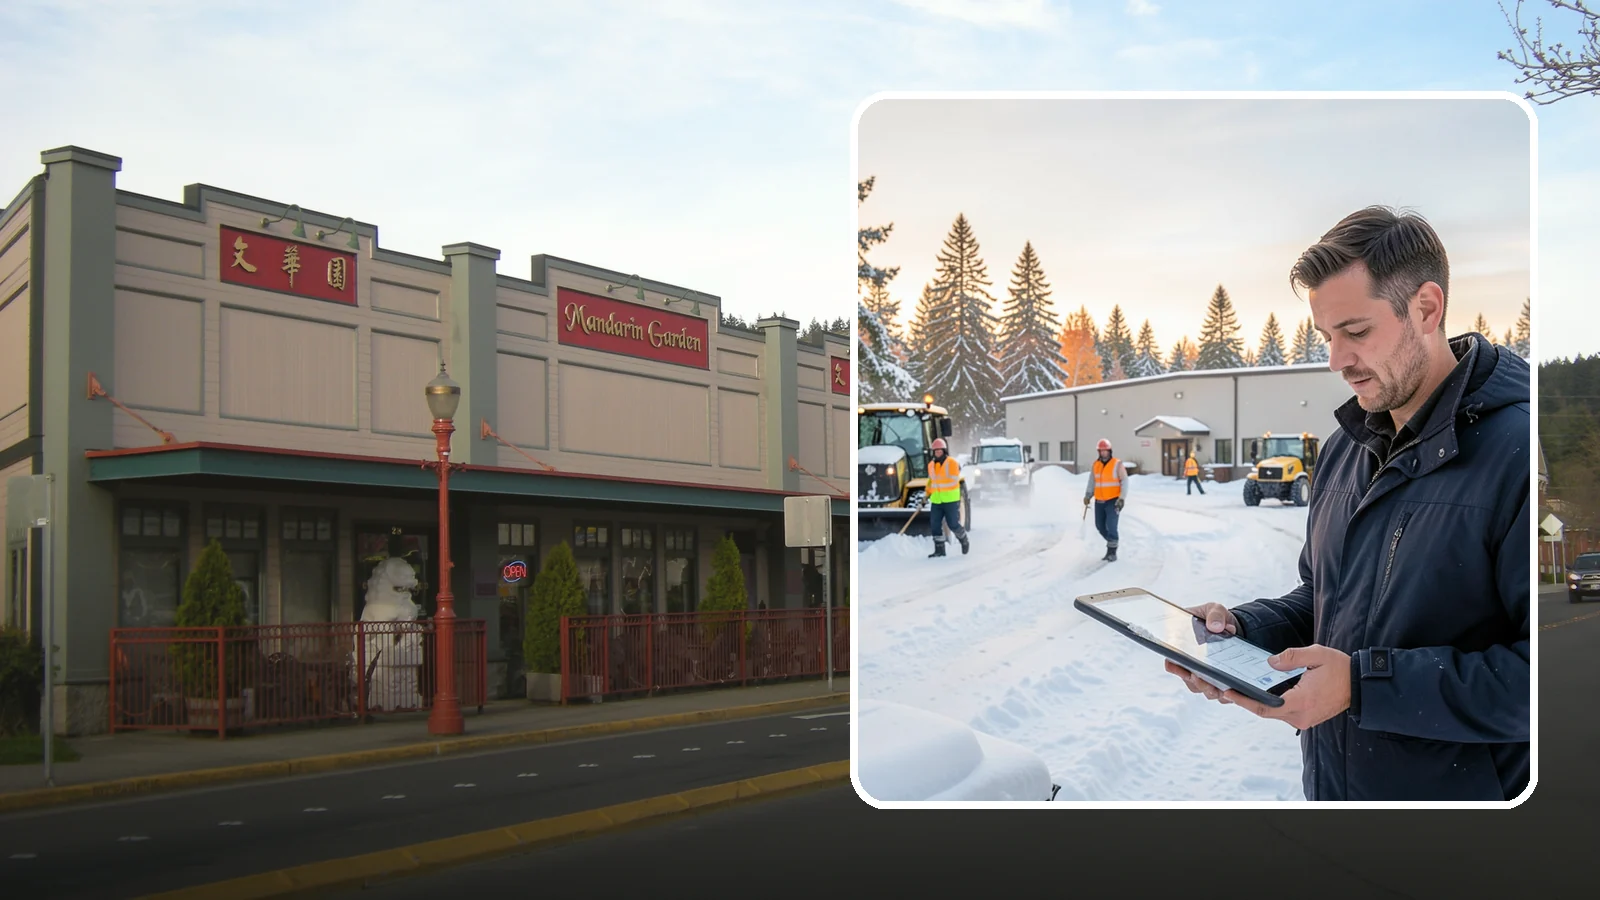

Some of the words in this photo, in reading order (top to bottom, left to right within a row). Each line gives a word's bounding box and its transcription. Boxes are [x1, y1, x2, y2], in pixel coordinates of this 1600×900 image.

[230, 235, 347, 291] 文華園
[564, 302, 644, 341] Mandarin
[647, 320, 702, 352] Garden
[834, 362, 847, 387] 文
[503, 565, 527, 579] OPEN
